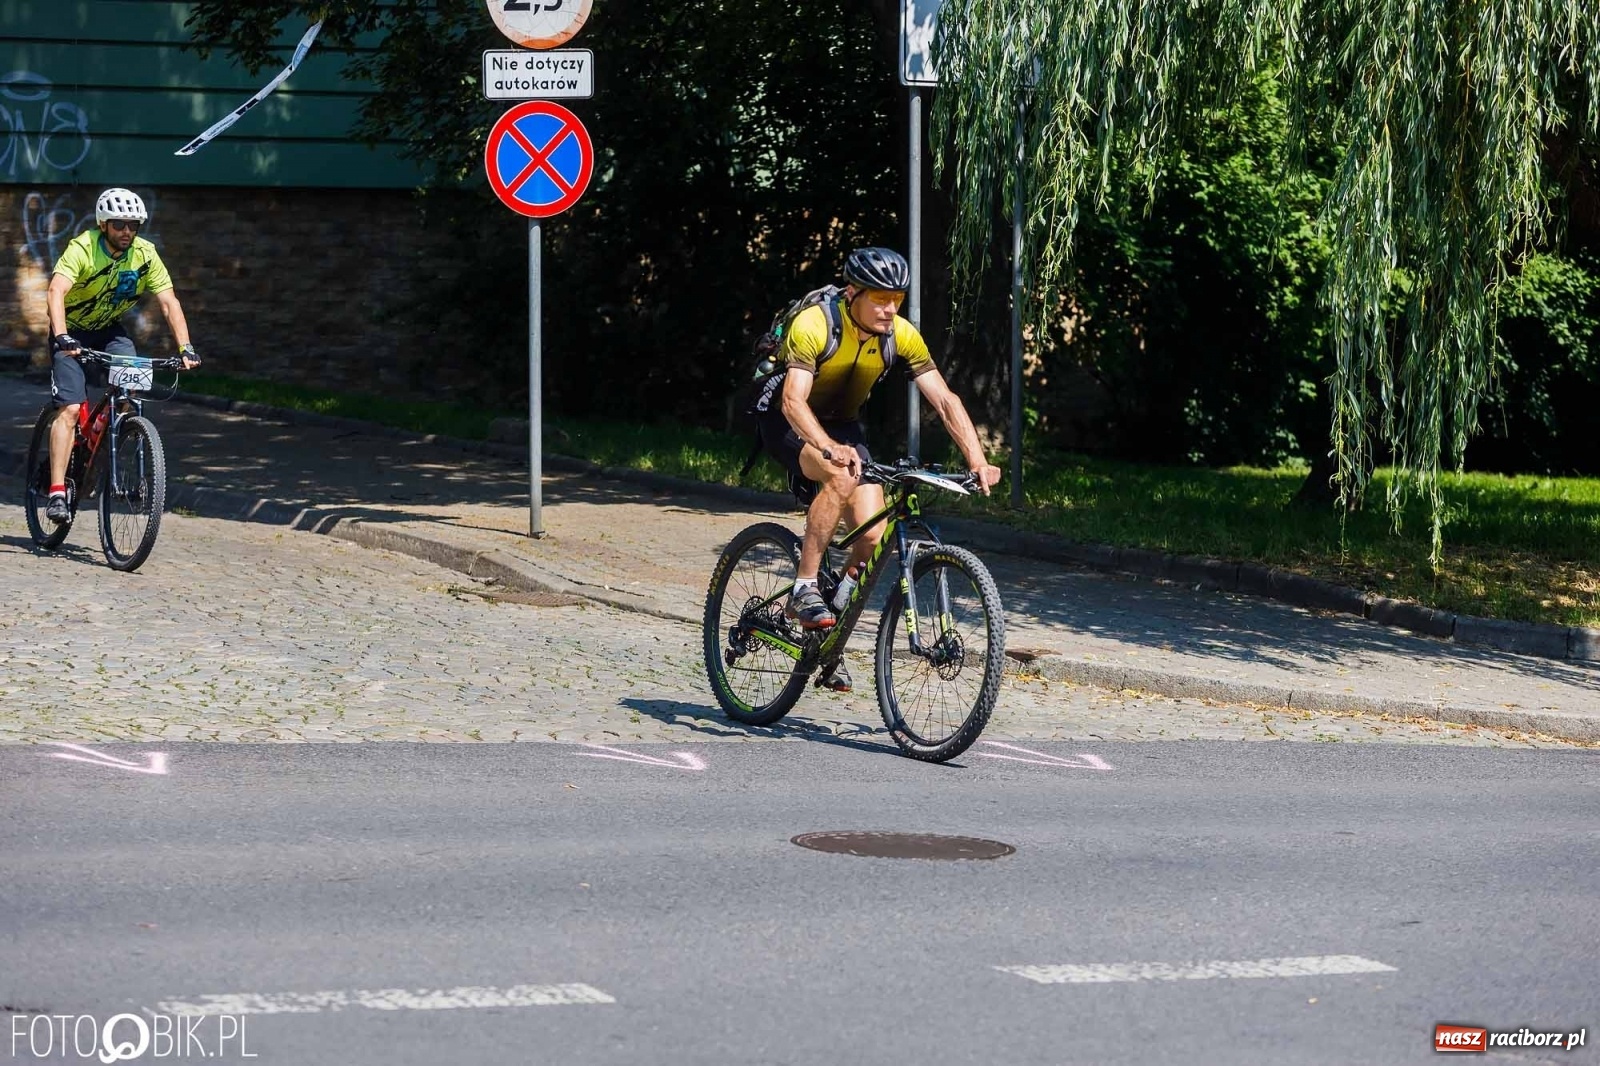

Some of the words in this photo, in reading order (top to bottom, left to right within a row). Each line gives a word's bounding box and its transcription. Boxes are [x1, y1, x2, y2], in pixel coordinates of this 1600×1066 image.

[492, 57, 518, 70] Nie
[525, 57, 584, 73] dotyczy
[494, 76, 578, 90] autokarów
[122, 373, 140, 383] 215
